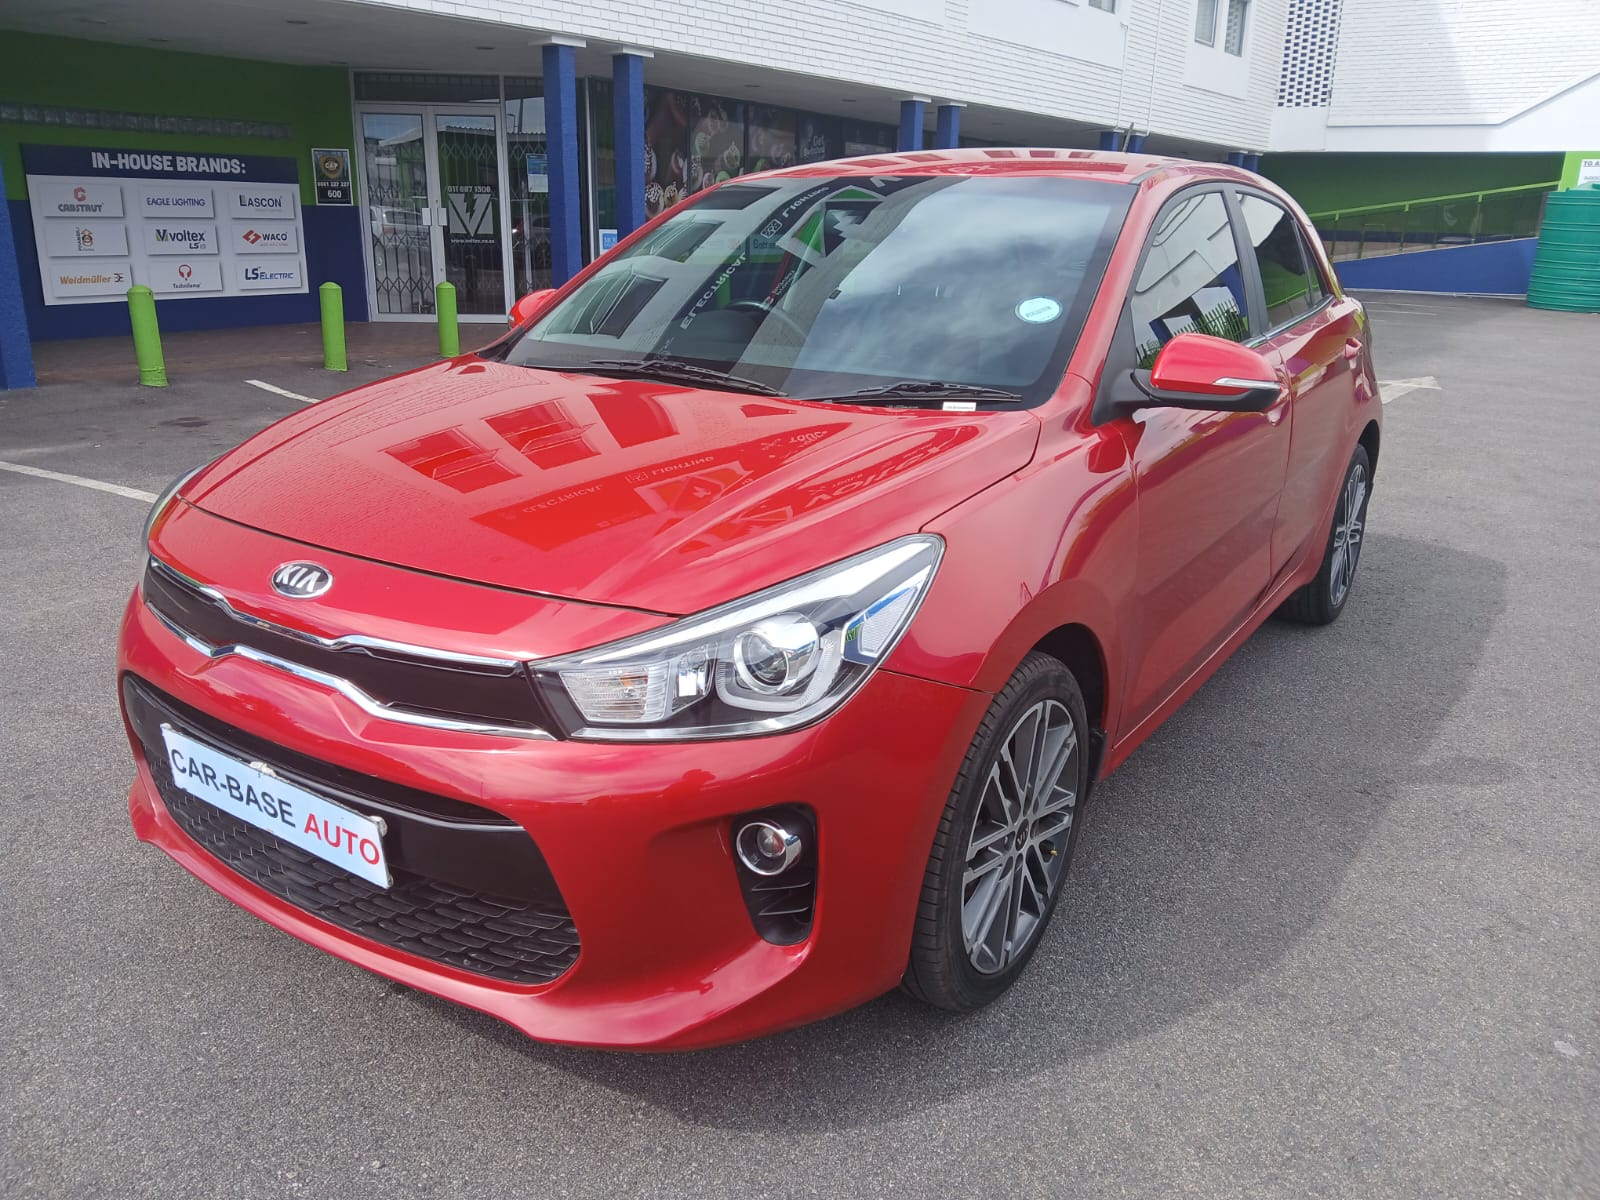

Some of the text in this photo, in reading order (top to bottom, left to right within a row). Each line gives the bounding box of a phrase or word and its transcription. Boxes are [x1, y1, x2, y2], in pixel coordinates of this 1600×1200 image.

[91, 152, 247, 174] IN-HOUSE BRANDS:
[239, 194, 282, 208] LASCON
[327, 190, 342, 199] 600
[146, 197, 206, 207] EAGLE LIGHTING
[262, 233, 288, 241] WACO
[60, 274, 111, 285] Weidmüller
[245, 268, 259, 281] LS
[275, 563, 321, 592] KIA
[170, 748, 380, 865] CAR-BASE AUTO
